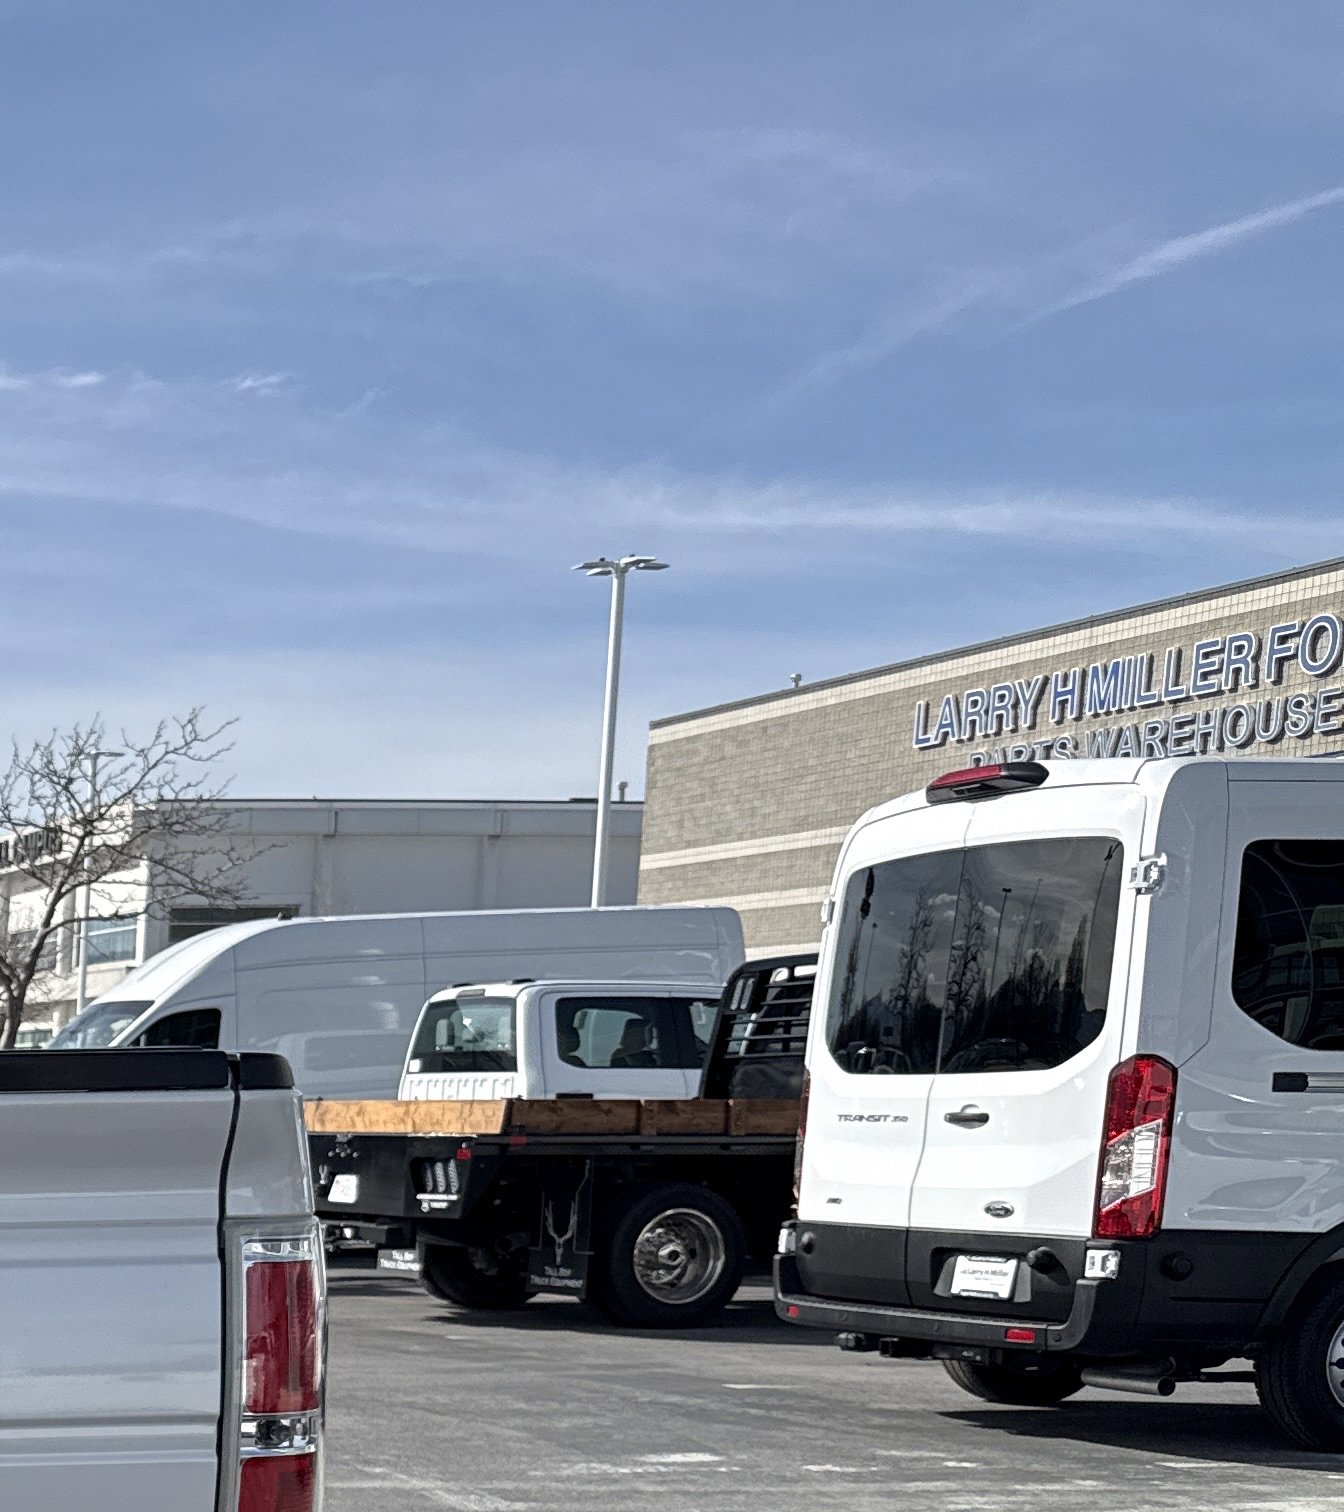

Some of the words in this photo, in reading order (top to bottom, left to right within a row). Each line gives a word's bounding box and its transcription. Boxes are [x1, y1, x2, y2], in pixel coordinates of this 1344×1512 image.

[912, 674, 1043, 748] LARRY
[1050, 667, 1079, 723] H
[1085, 631, 1256, 716] MILLER
[1265, 612, 1344, 683] FO
[1085, 687, 1342, 760] WAREHOUSE
